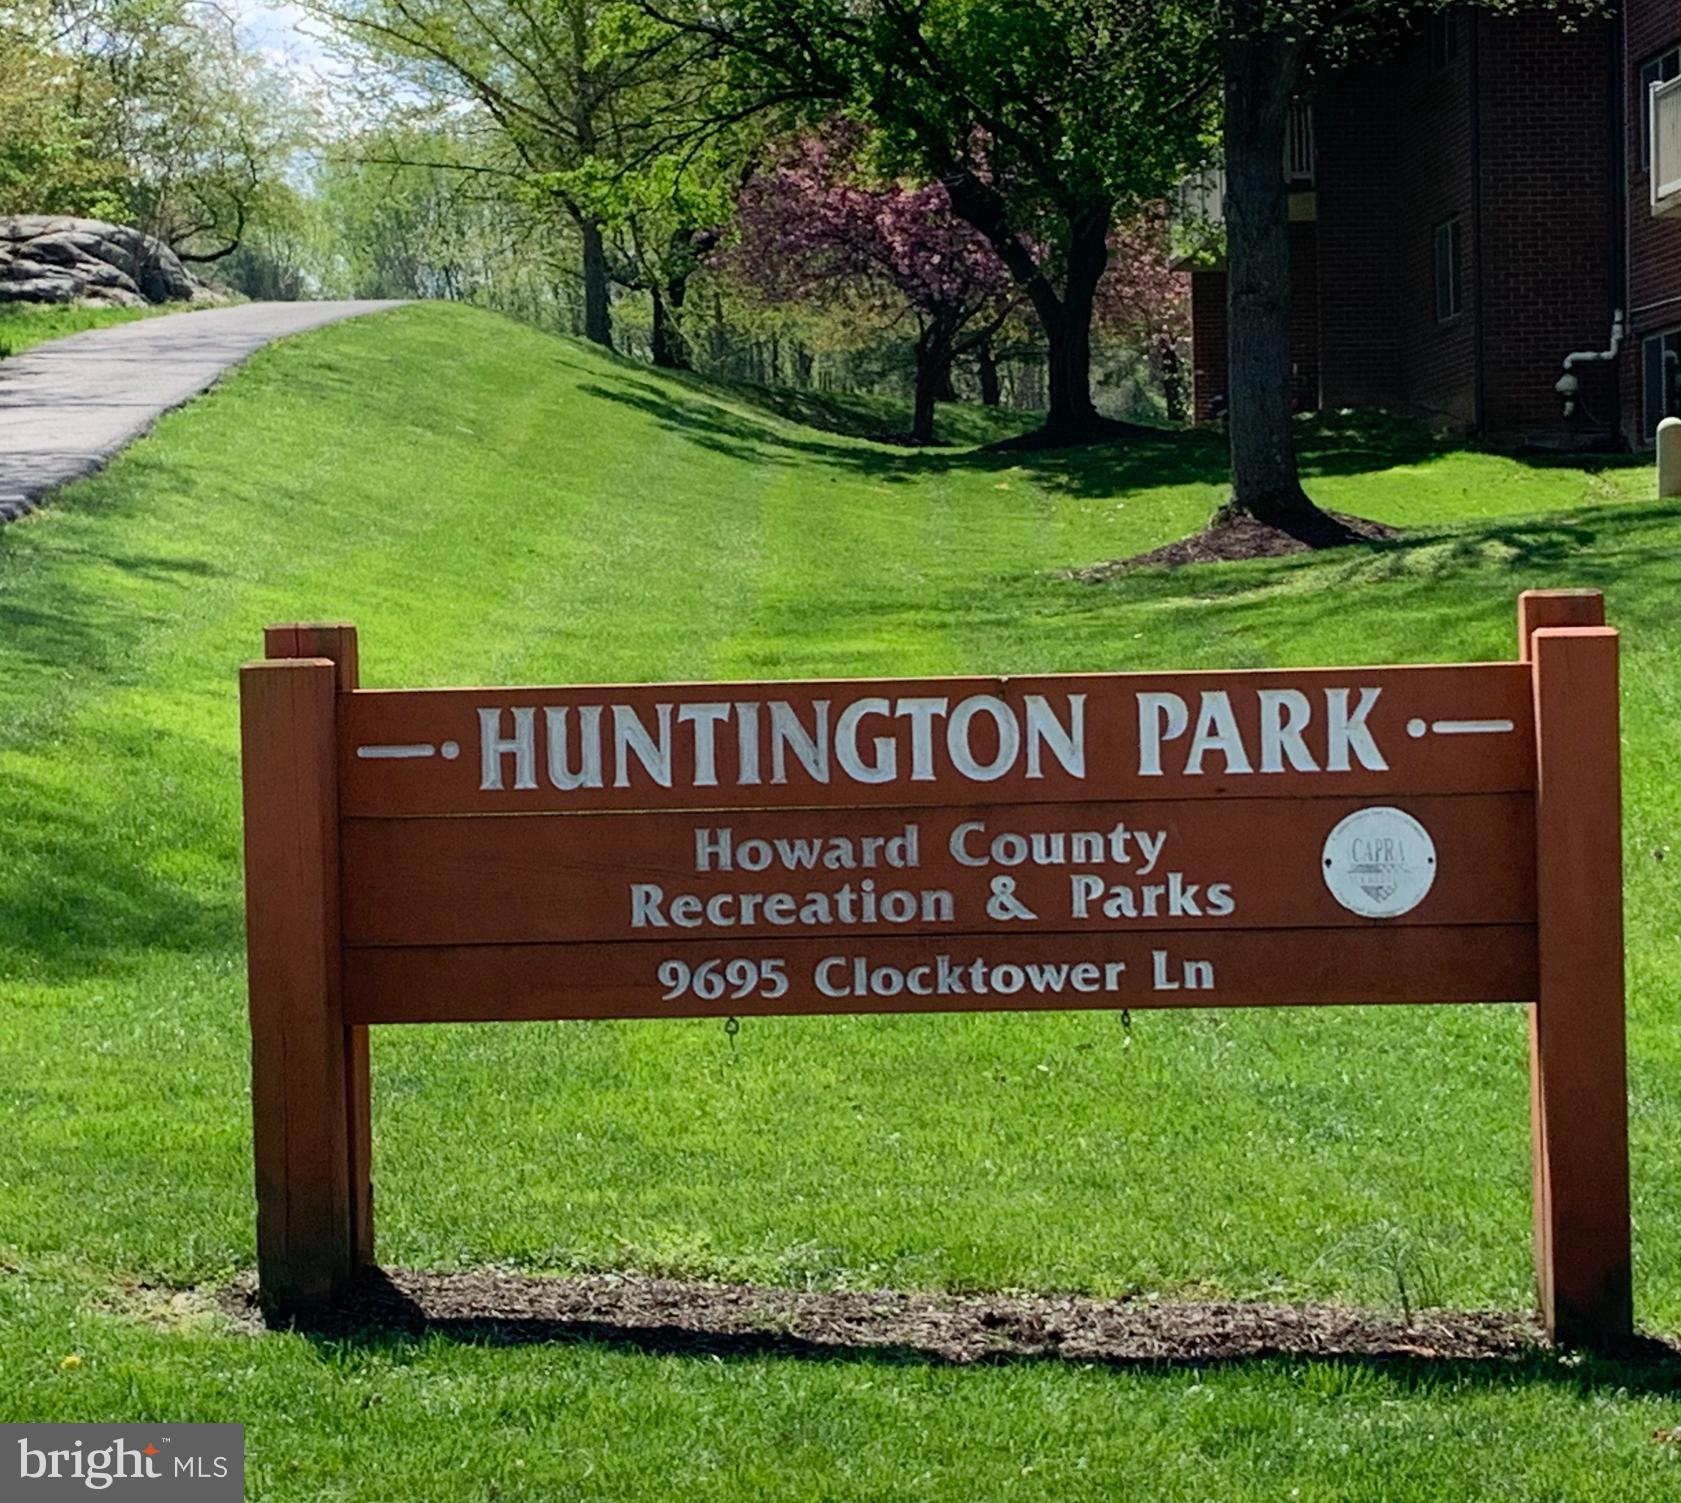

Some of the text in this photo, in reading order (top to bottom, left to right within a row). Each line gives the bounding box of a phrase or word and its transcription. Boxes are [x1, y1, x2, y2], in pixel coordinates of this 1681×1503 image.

[476, 686, 1390, 792] HUNTINGTON PARK
[694, 821, 1168, 876] Howard County
[1351, 837, 1406, 863] CAPRA
[630, 872, 1236, 928] Recreation & Parks
[657, 950, 1216, 1001] 9695 Clocktower Ln
